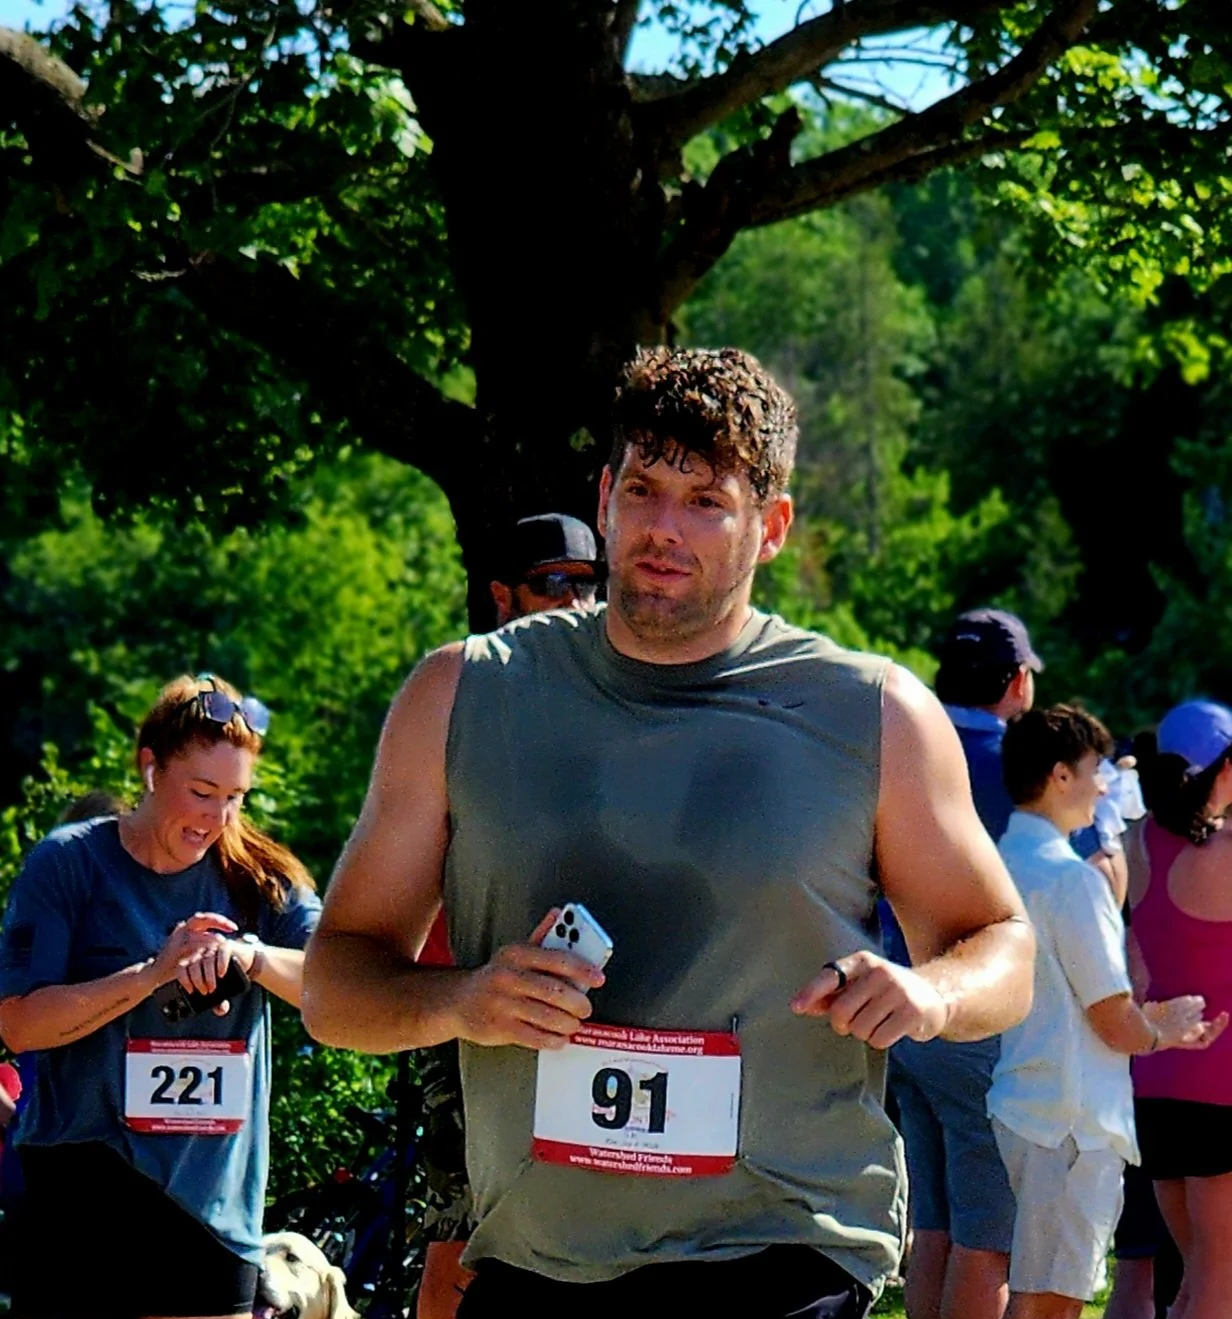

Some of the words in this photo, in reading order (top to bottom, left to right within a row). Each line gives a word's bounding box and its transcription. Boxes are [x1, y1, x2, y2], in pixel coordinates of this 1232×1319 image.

[652, 1033, 705, 1045] Association
[150, 1065, 223, 1105] 221
[592, 1067, 668, 1134] 91
[569, 1155, 693, 1174] www.watershedfriends.com
[588, 1147, 637, 1162] Watershed
[637, 1153, 673, 1165] Friends
